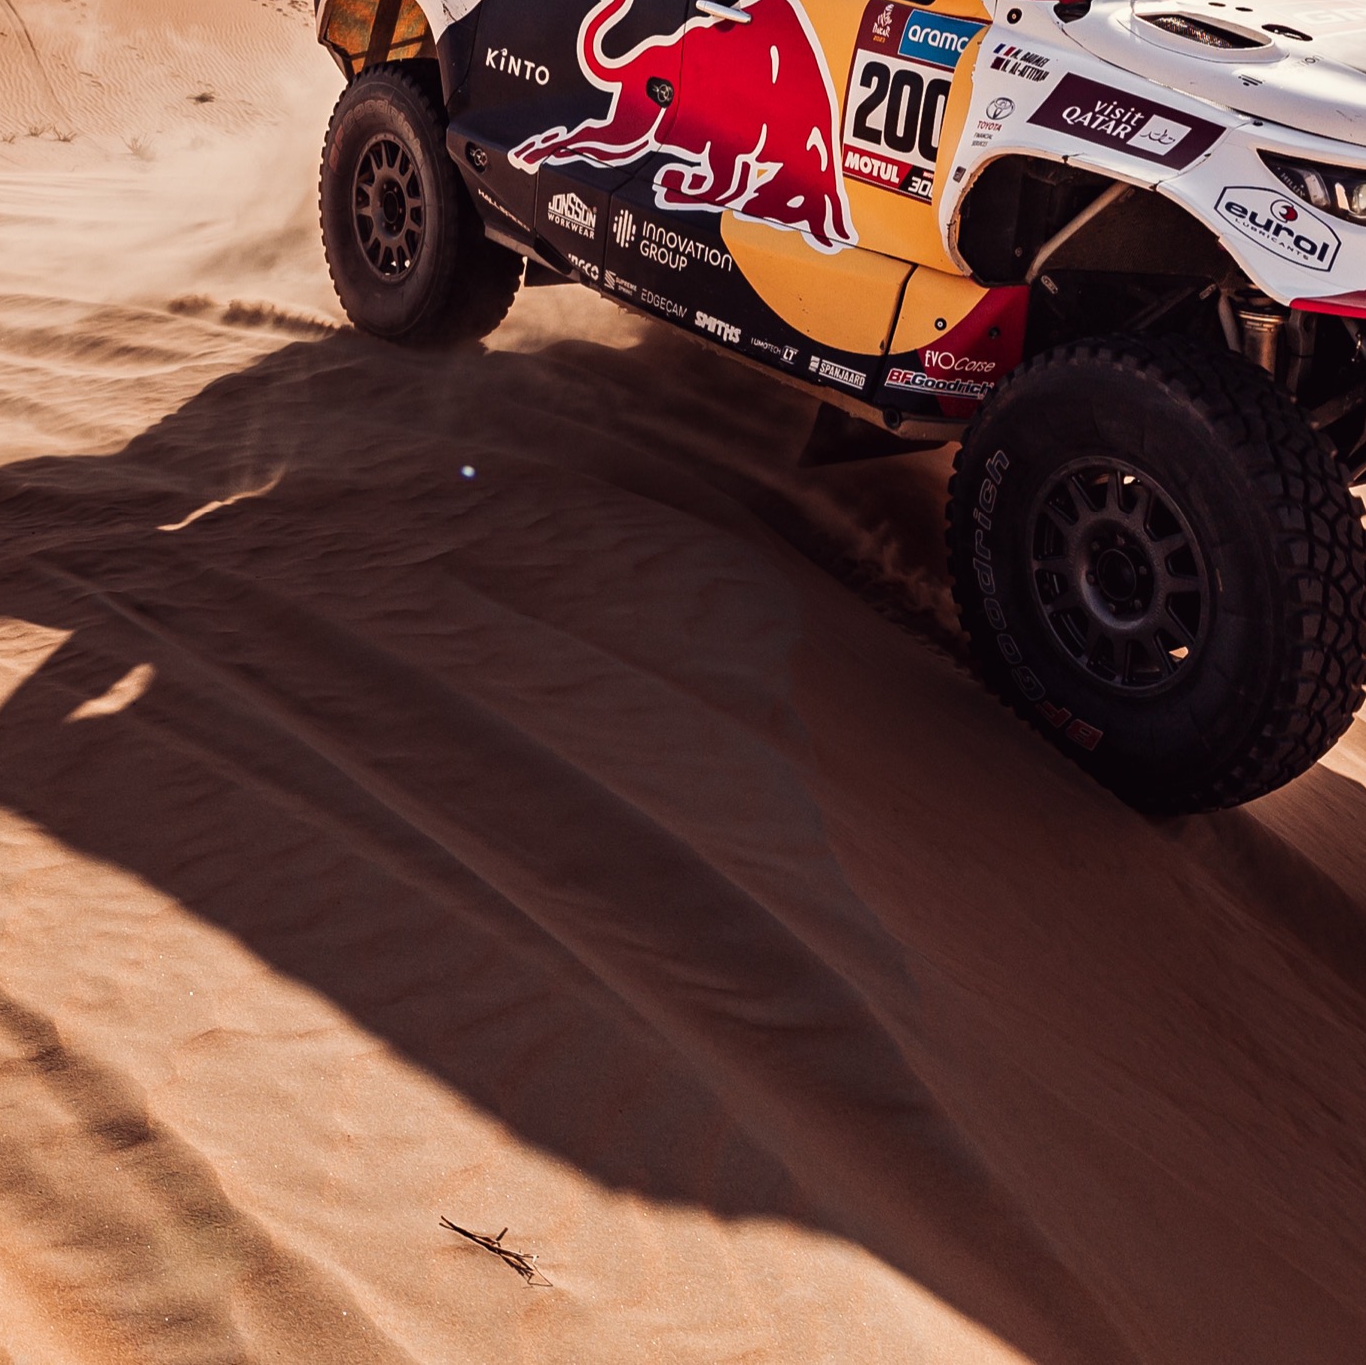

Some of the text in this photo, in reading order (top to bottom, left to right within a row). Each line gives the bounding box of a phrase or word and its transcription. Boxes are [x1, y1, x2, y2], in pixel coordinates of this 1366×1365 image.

[908, 23, 970, 54] aramc
[852, 60, 952, 164] 200
[977, 120, 1003, 132] TOYOTA
[1061, 106, 1133, 140] QATAR
[1094, 100, 1145, 126] visit
[844, 150, 900, 185] MOTUL
[547, 192, 597, 229] JONSSON
[547, 211, 596, 240] WORKWEAR
[642, 220, 733, 273] INNOVATION
[1224, 201, 1330, 263] eurol
[1235, 217, 1309, 261] LUBRICANTS
[639, 240, 688, 272] GROUP
[694, 310, 742, 345] SMITHS
[819, 361, 867, 387] SPANJAARD
[885, 367, 993, 396] BFGoodrich
